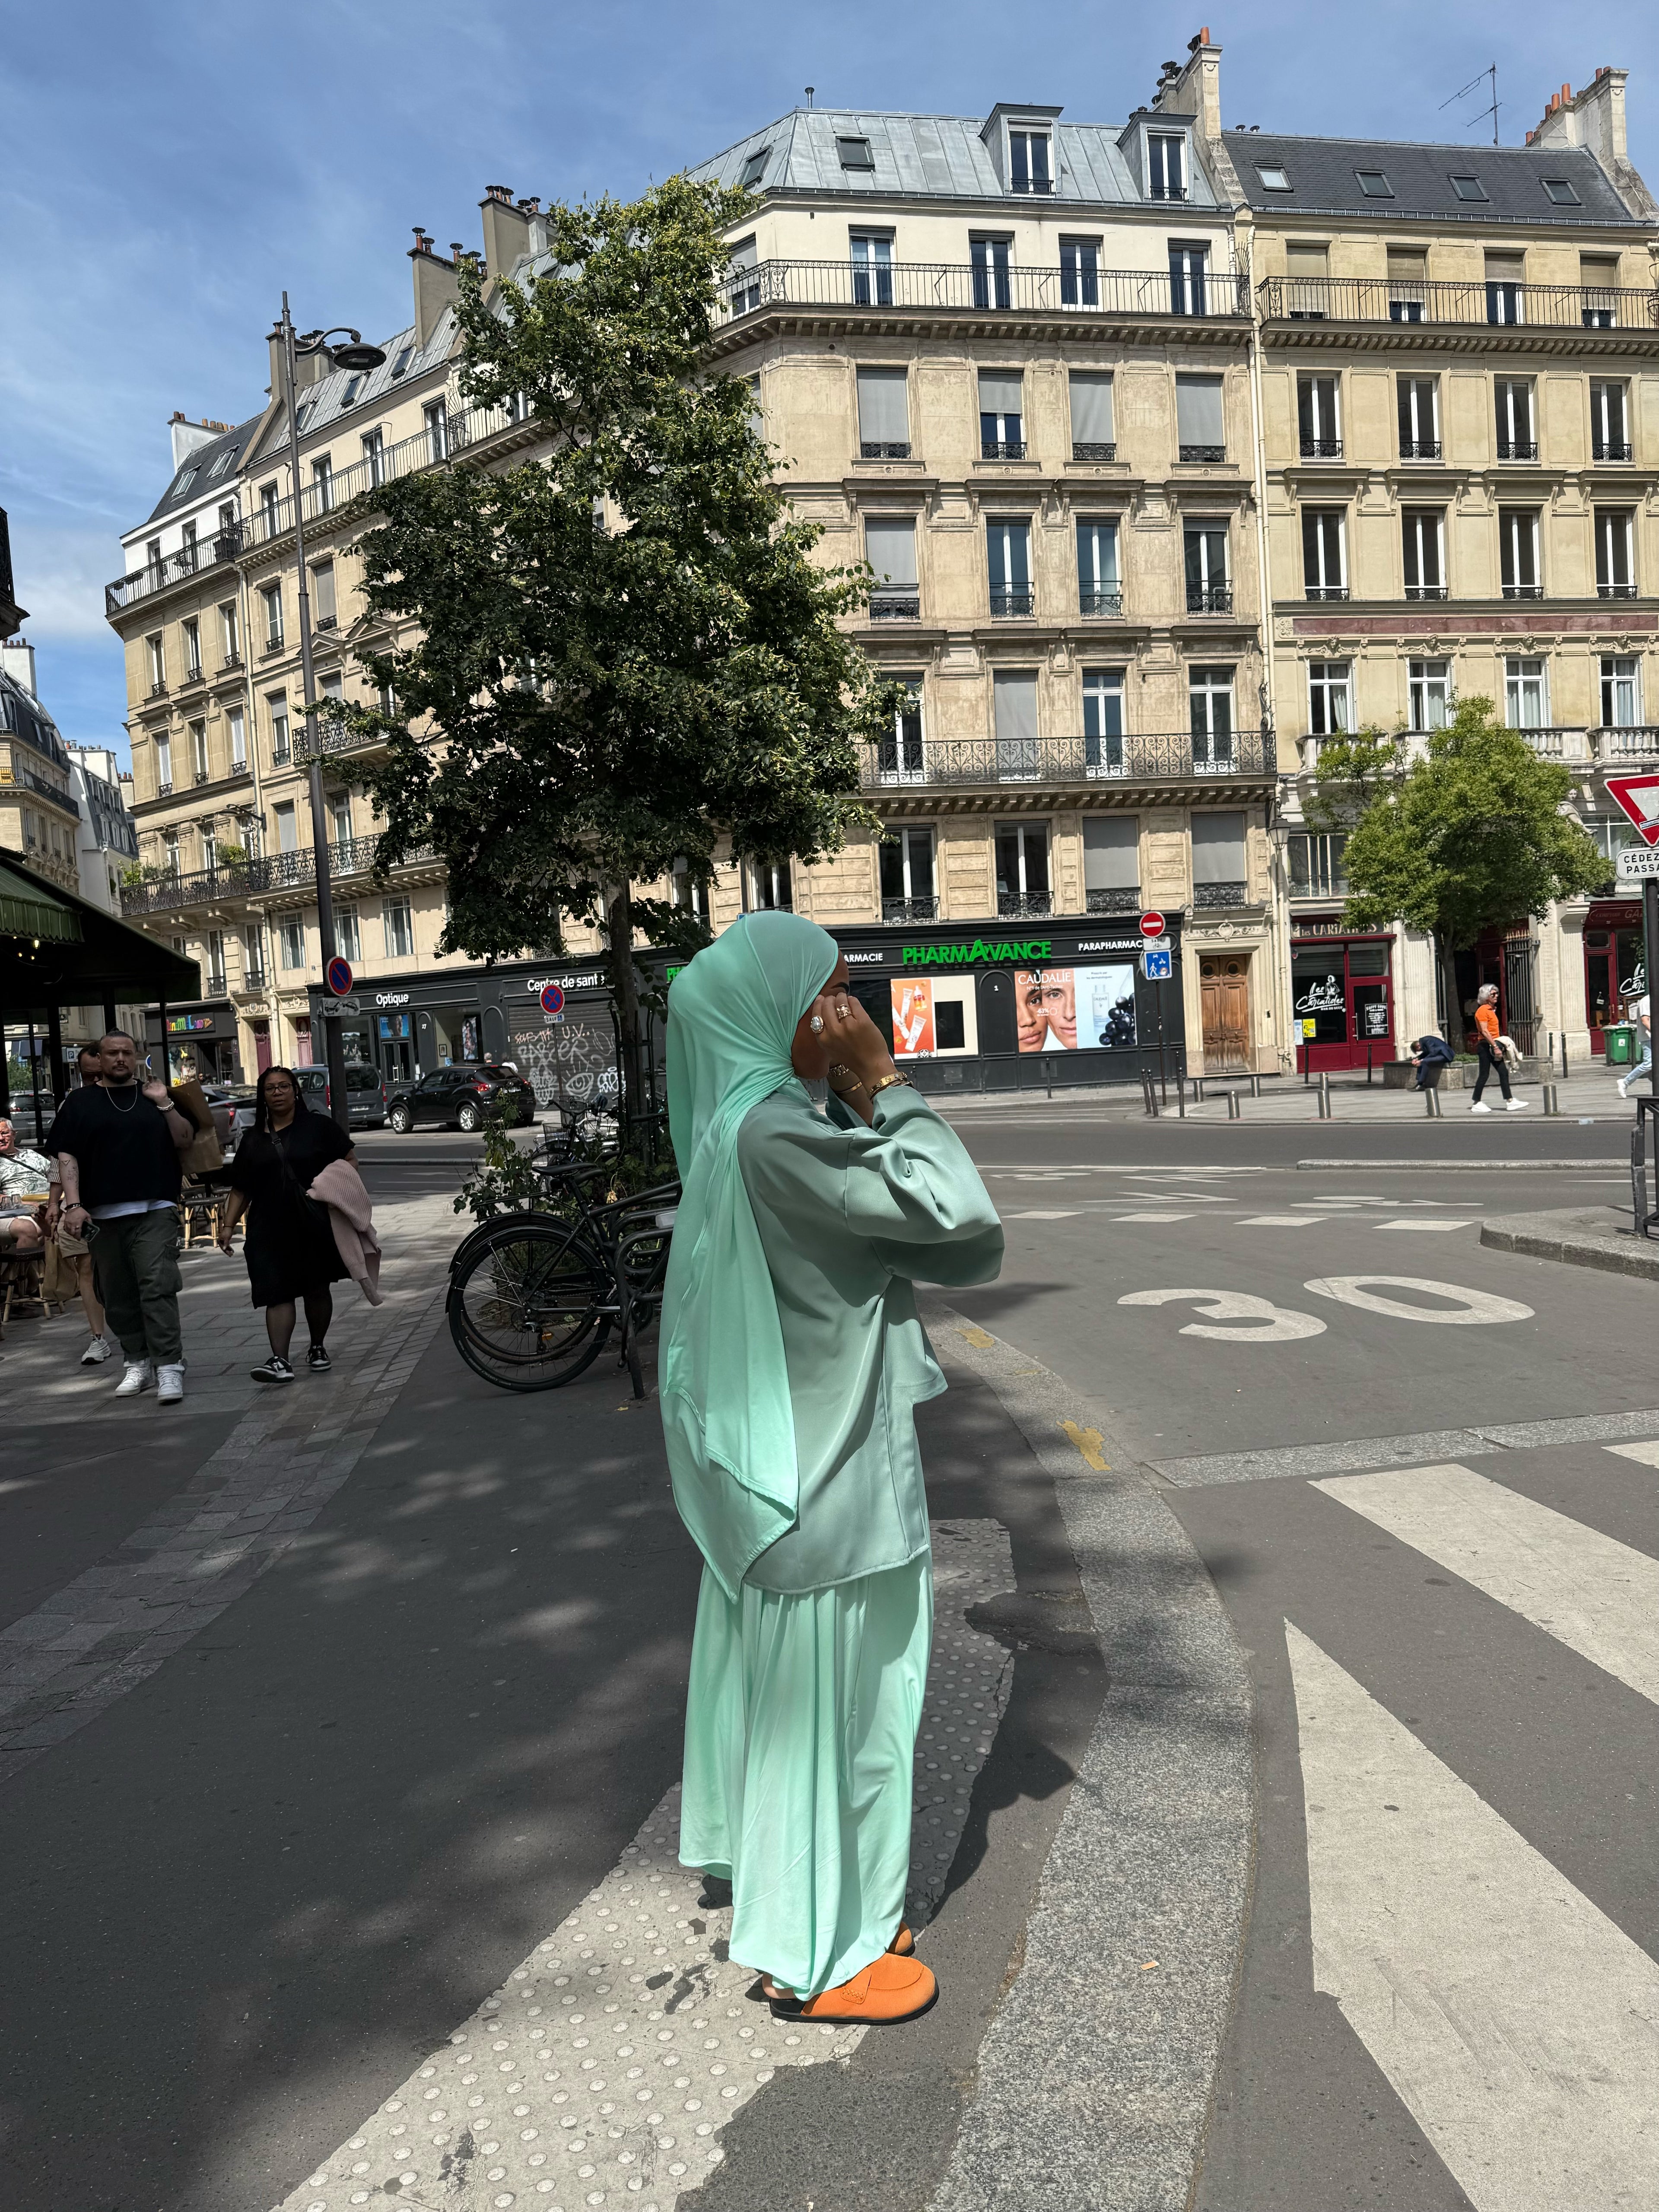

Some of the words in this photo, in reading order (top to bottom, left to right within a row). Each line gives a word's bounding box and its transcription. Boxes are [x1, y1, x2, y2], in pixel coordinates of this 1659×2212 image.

[1624, 854, 1659, 863] CÉDEZ
[1078, 940, 1143, 951] PARAPHARMAC
[562, 975, 575, 988] de
[376, 993, 409, 1008] Optique
[1116, 1275, 1535, 1341] 30
